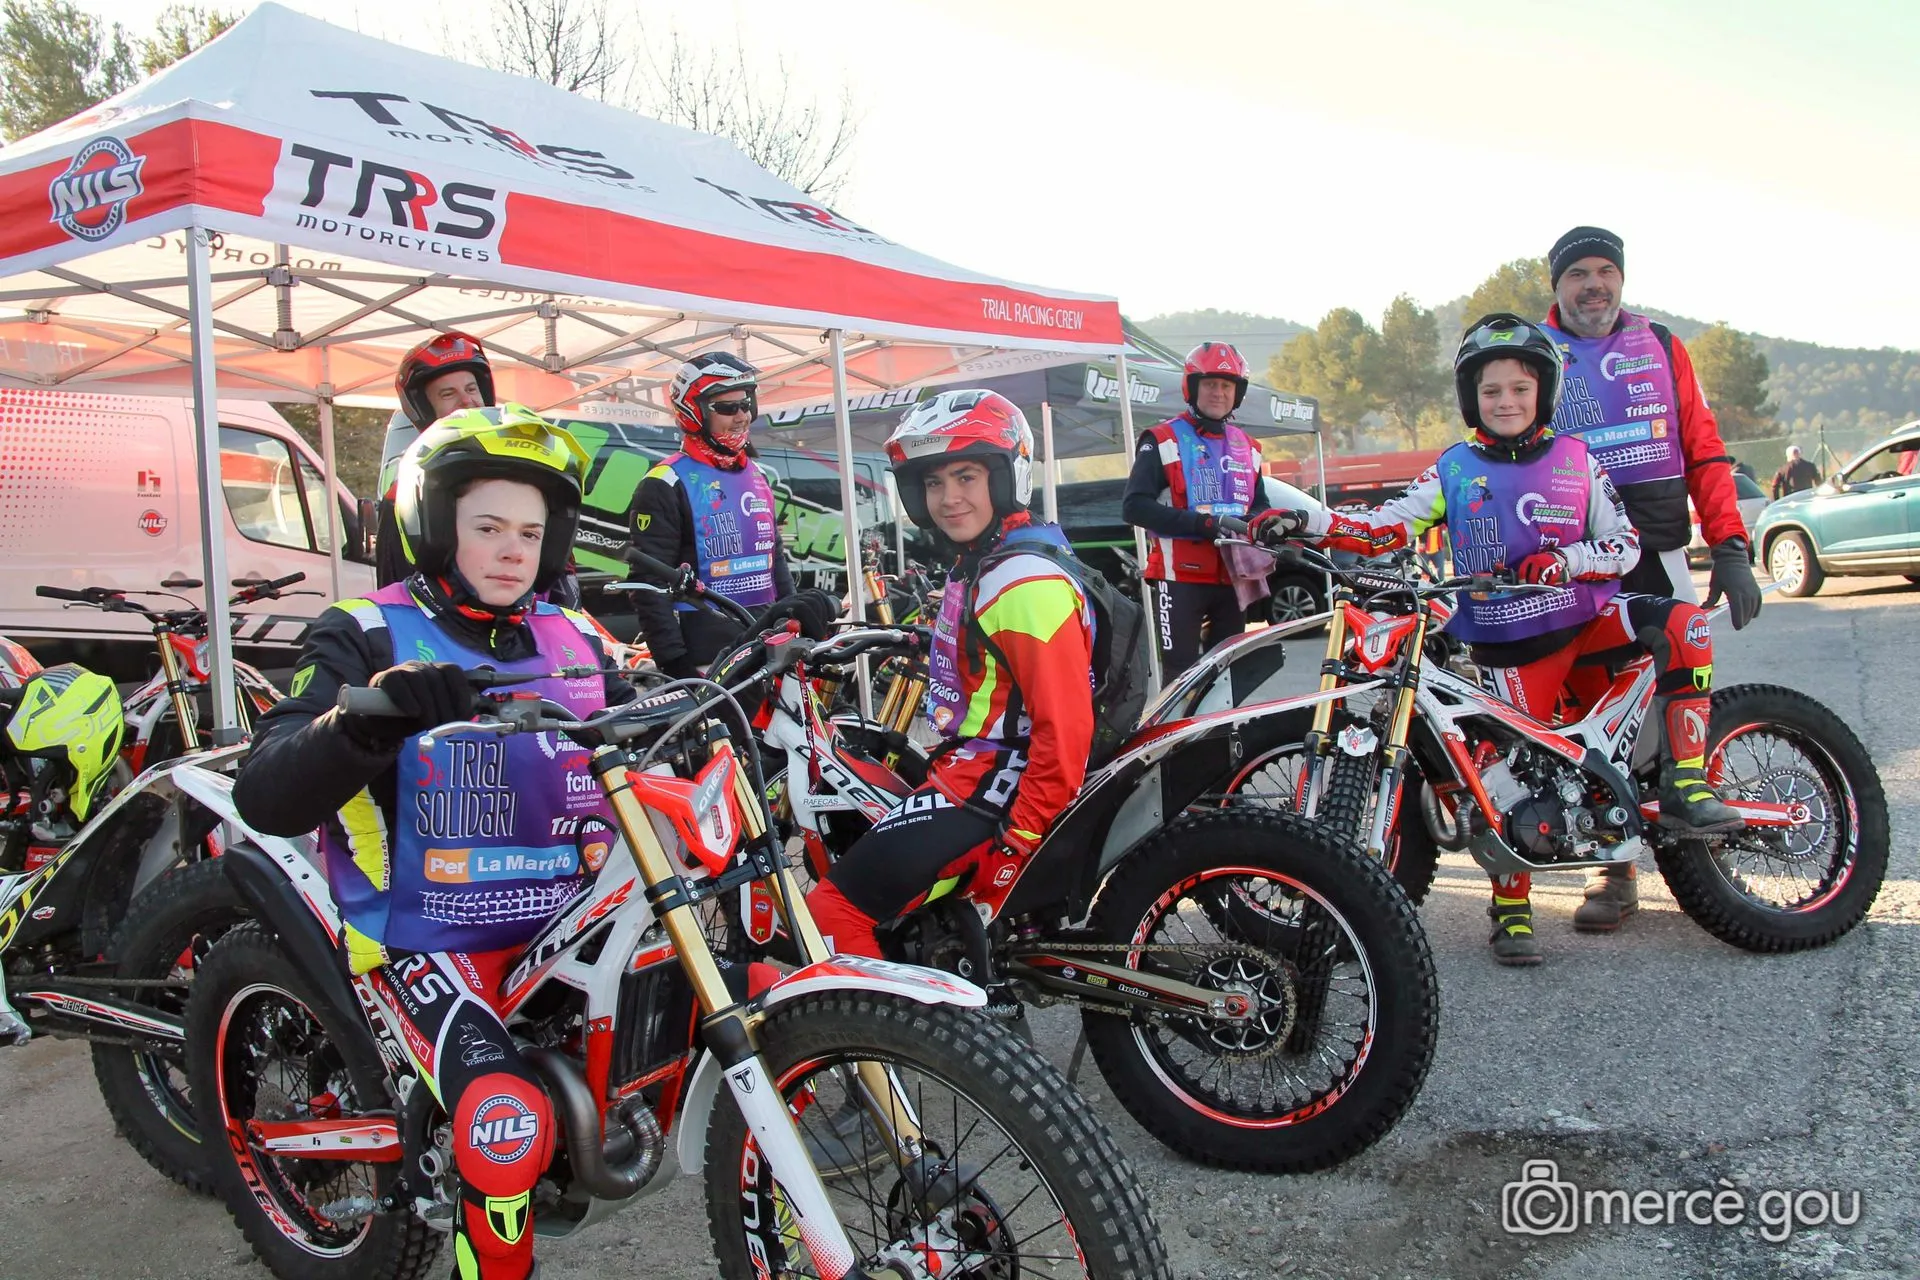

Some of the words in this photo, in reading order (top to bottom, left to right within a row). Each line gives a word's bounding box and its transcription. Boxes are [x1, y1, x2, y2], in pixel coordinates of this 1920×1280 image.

[54, 162, 140, 219] NILS
[295, 213, 490, 262] MOTORCYCLES
[980, 297, 1013, 323] TRIAL
[1014, 302, 1054, 327] RACING
[1055, 308, 1084, 330] CREW
[1614, 357, 1653, 370] CIRCUIT
[1627, 381, 1655, 396] fcm
[1625, 403, 1668, 418] TrialGo
[940, 417, 968, 432] hebo
[1604, 427, 1647, 443] Marató
[504, 439, 552, 456] MOTS
[1531, 515, 1580, 526] PARCMOTOR
[1532, 508, 1574, 518] CIRCUIT
[139, 518, 167, 529] NILS
[756, 520, 771, 531] fcm
[565, 770, 597, 793] fcm
[803, 798, 839, 806] RAFECAS
[893, 820, 907, 828] PRO
[908, 815, 933, 823] SERIES
[429, 857, 467, 875] Per
[477, 855, 501, 873] La
[505, 853, 571, 872] Marató
[1118, 983, 1149, 998] hebo
[62, 999, 89, 1014] REIGER
[471, 1113, 537, 1146] NILS
